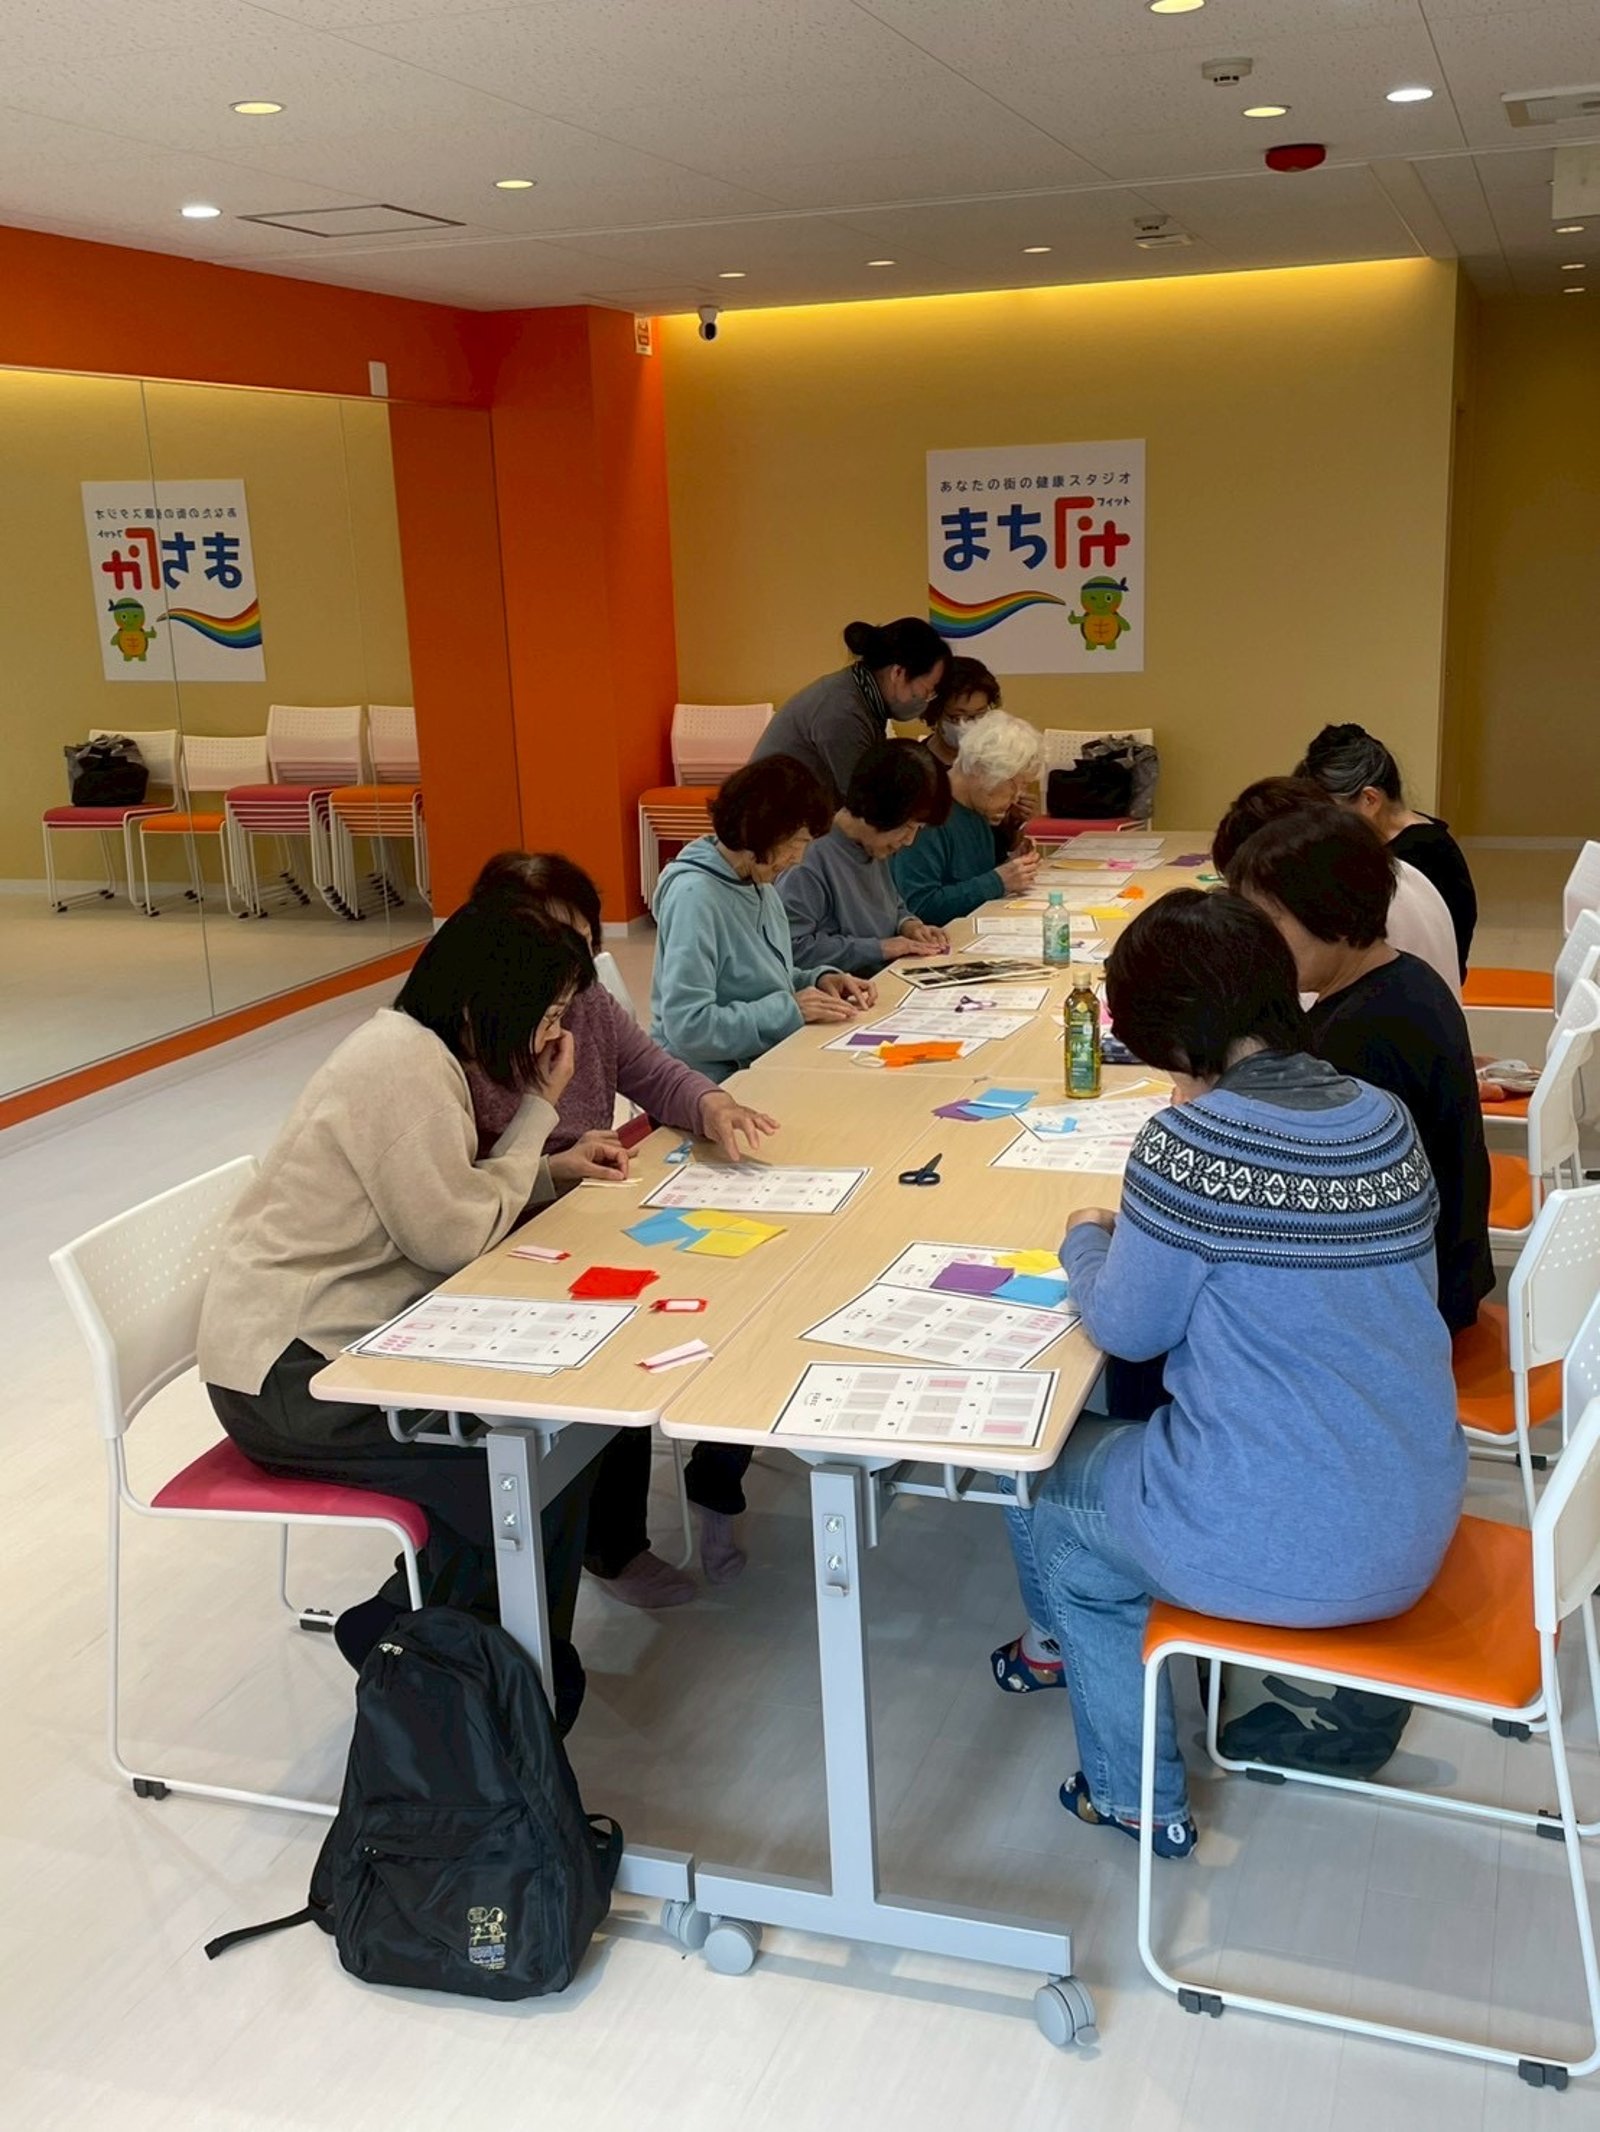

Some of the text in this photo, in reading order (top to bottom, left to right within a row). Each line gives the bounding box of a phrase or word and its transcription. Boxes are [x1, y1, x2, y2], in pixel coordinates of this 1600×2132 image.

[940, 472, 1131, 492] あなたの街の健康スタジオ
[1097, 496, 1131, 508] フィット
